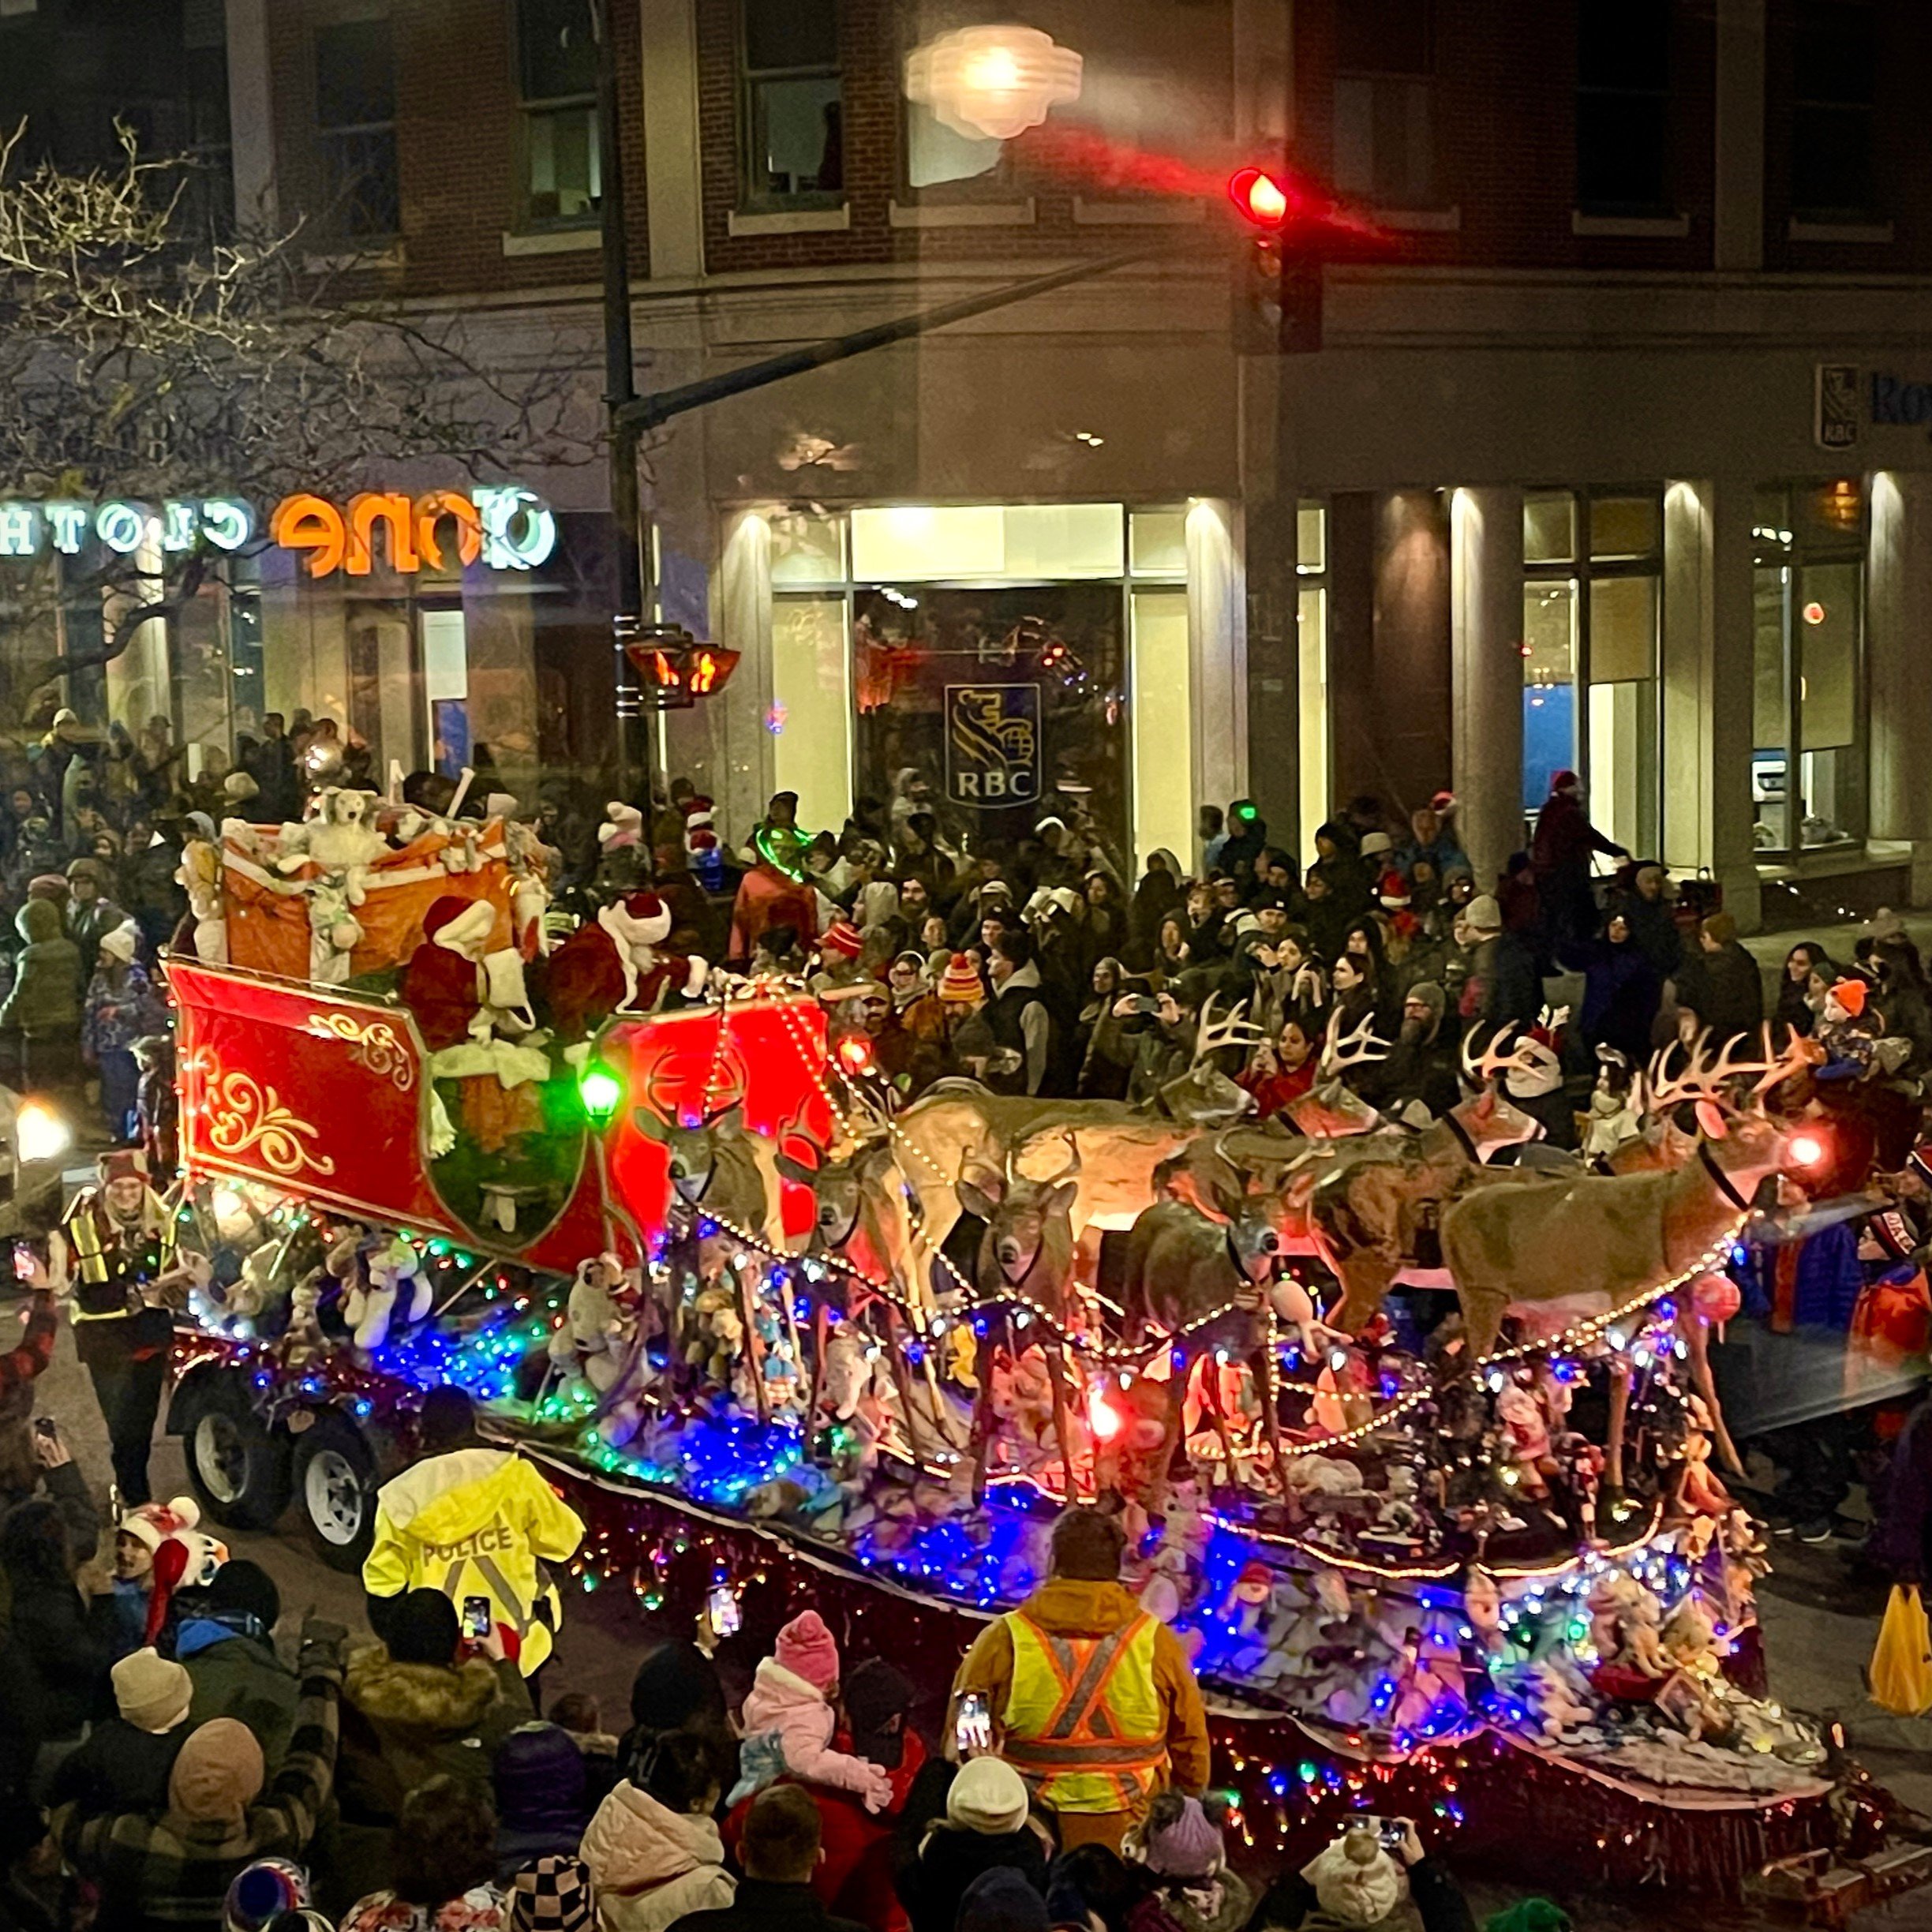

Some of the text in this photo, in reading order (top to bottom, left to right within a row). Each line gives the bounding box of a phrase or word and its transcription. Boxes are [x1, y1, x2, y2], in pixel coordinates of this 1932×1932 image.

[1872, 371, 1932, 432] Ro
[1825, 423, 1855, 442] RBC
[957, 771, 1031, 797] RBC
[423, 1526, 513, 1567] POLICE
